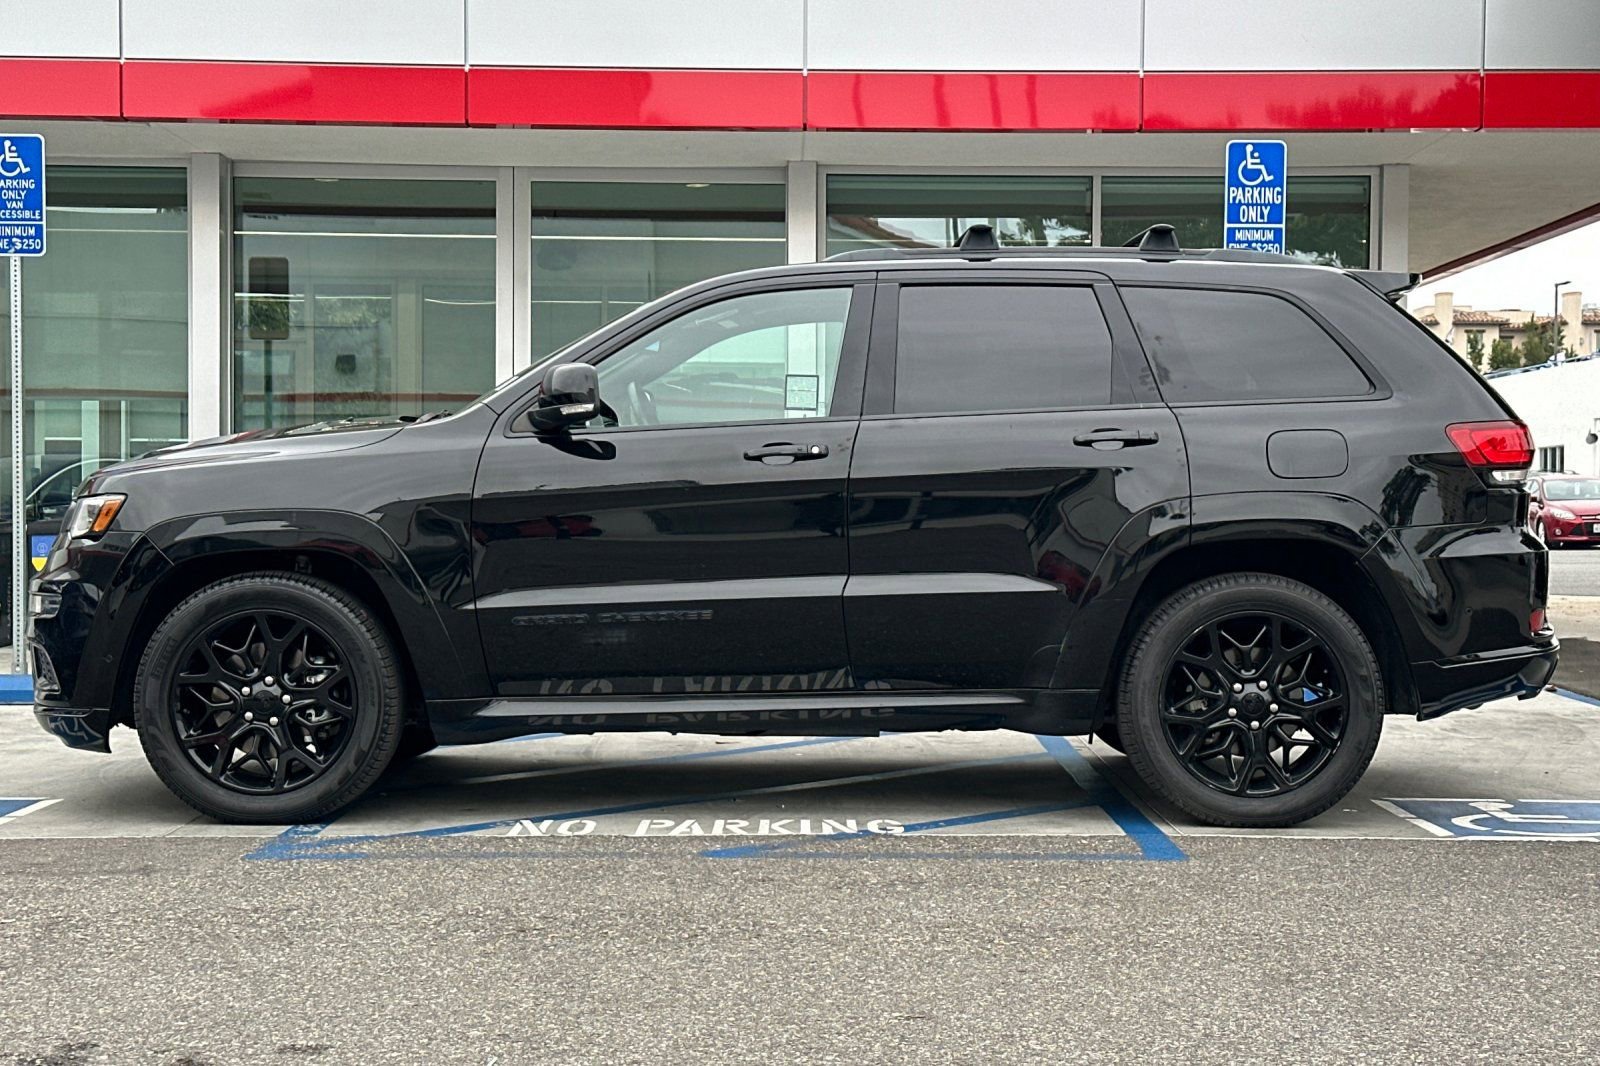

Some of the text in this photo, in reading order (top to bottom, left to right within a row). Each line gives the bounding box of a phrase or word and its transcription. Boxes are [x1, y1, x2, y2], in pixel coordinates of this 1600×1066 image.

[0, 179, 35, 189] ARKING
[1, 190, 27, 199] ONLY
[1229, 187, 1282, 204] PARKING
[6, 201, 24, 209] VAN
[0, 210, 41, 219] CESSIBLE
[1240, 205, 1271, 223] ONLY
[1235, 229, 1274, 241] MINIMUM
[505, 819, 906, 837] NO PARKING
